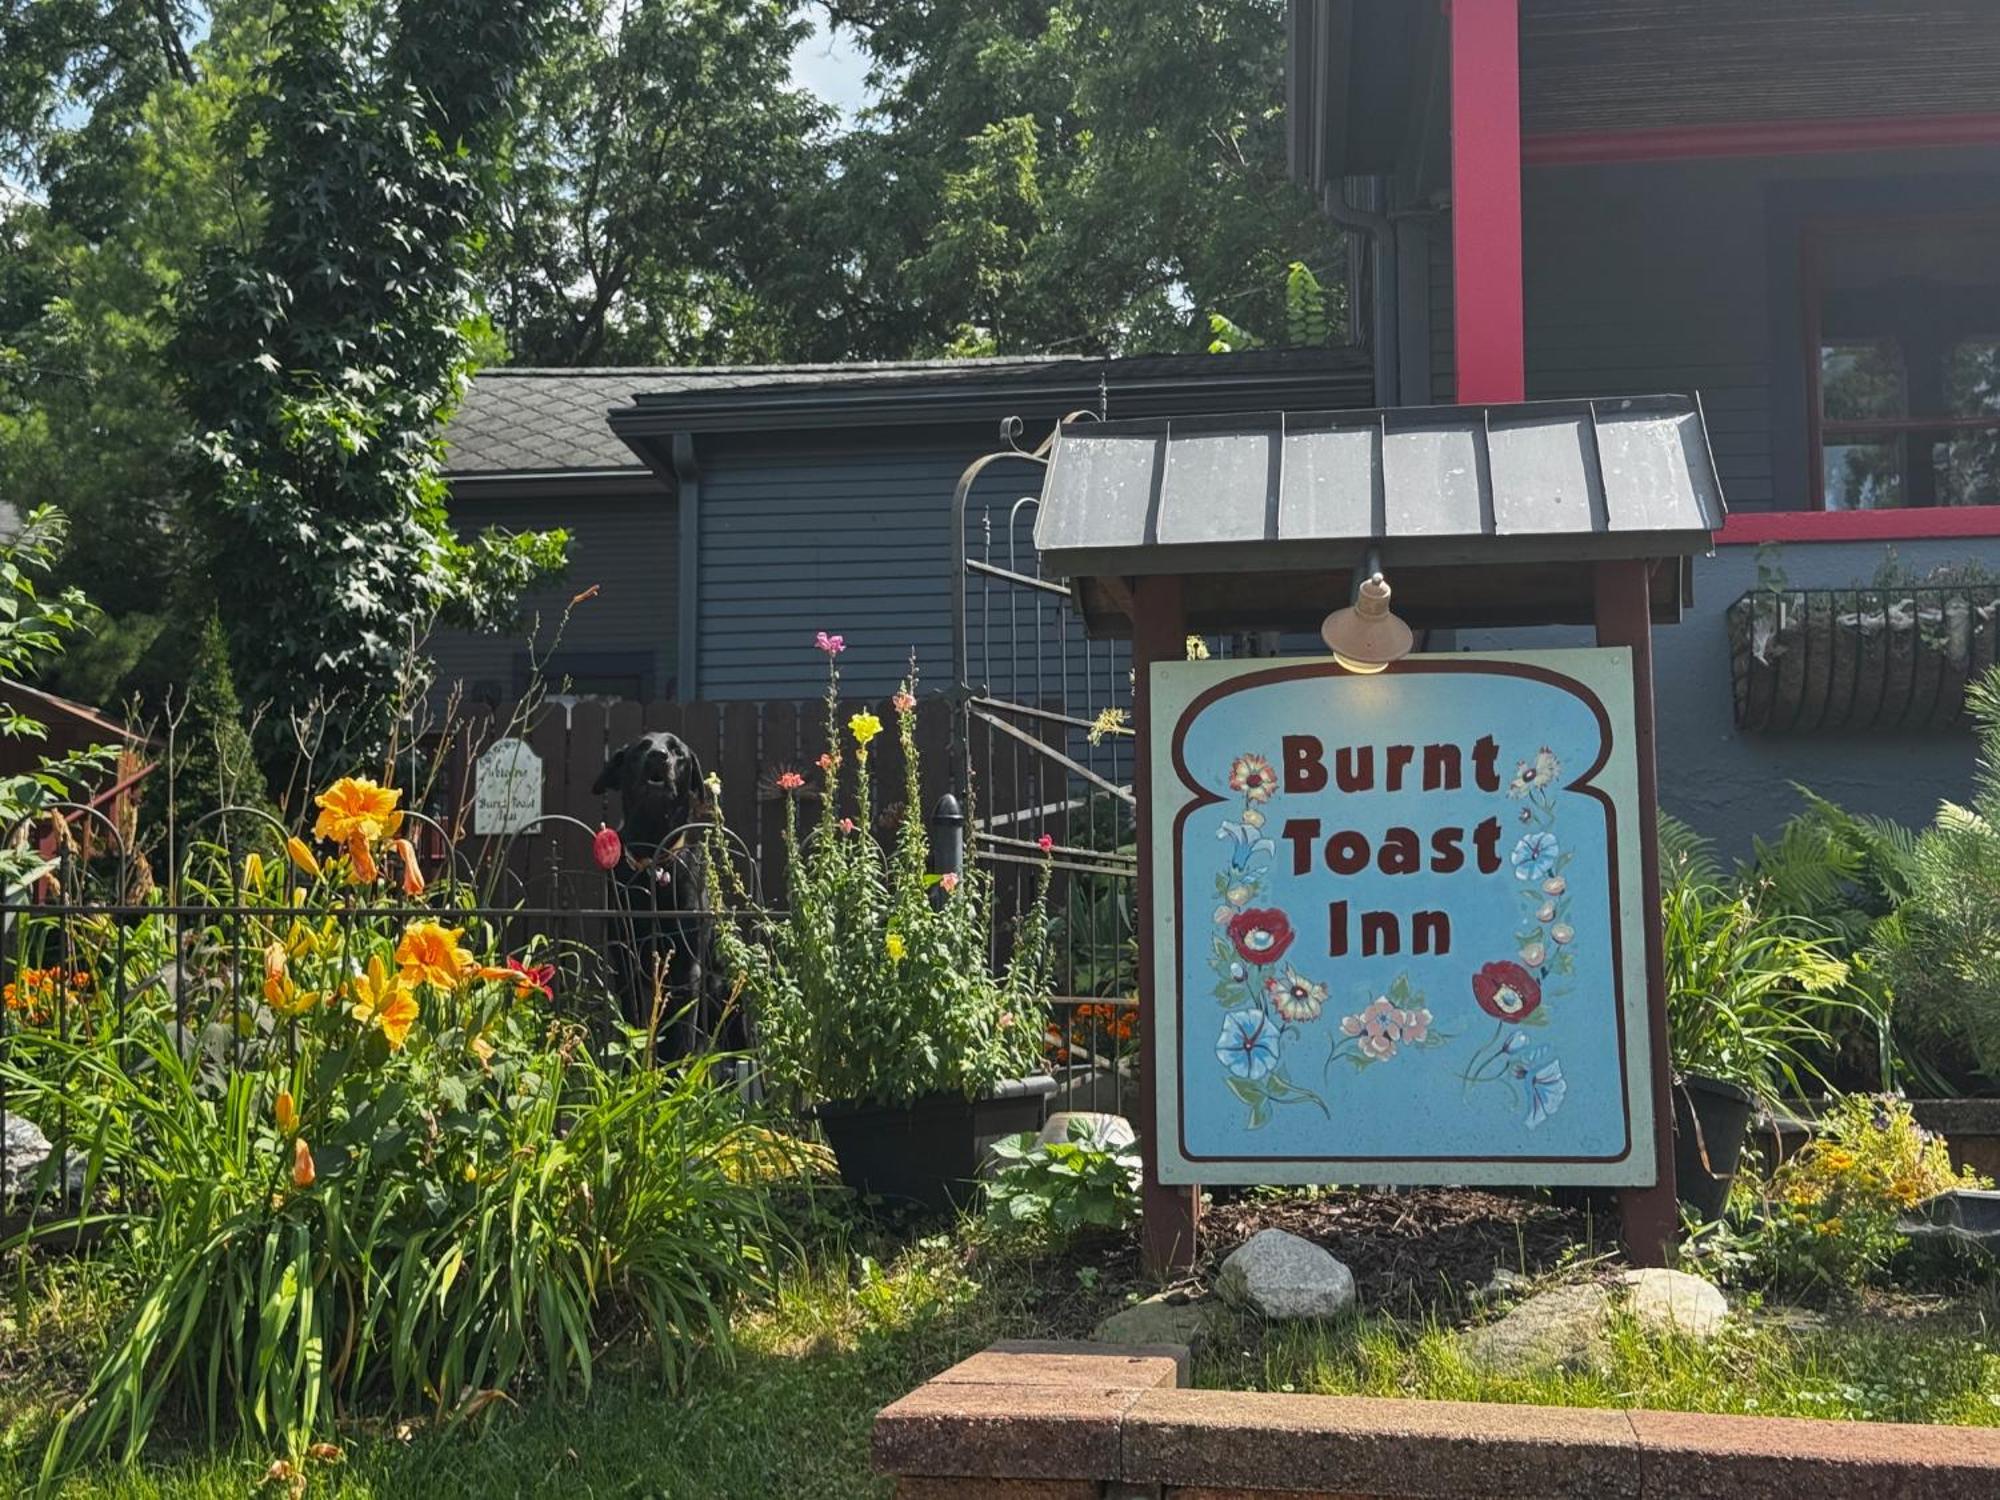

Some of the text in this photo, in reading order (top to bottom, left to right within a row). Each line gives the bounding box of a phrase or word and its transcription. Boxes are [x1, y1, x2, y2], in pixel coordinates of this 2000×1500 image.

[1282, 734, 1500, 793] Burnt
[1282, 816, 1502, 876] Toast
[1329, 900, 1451, 957] Inn
